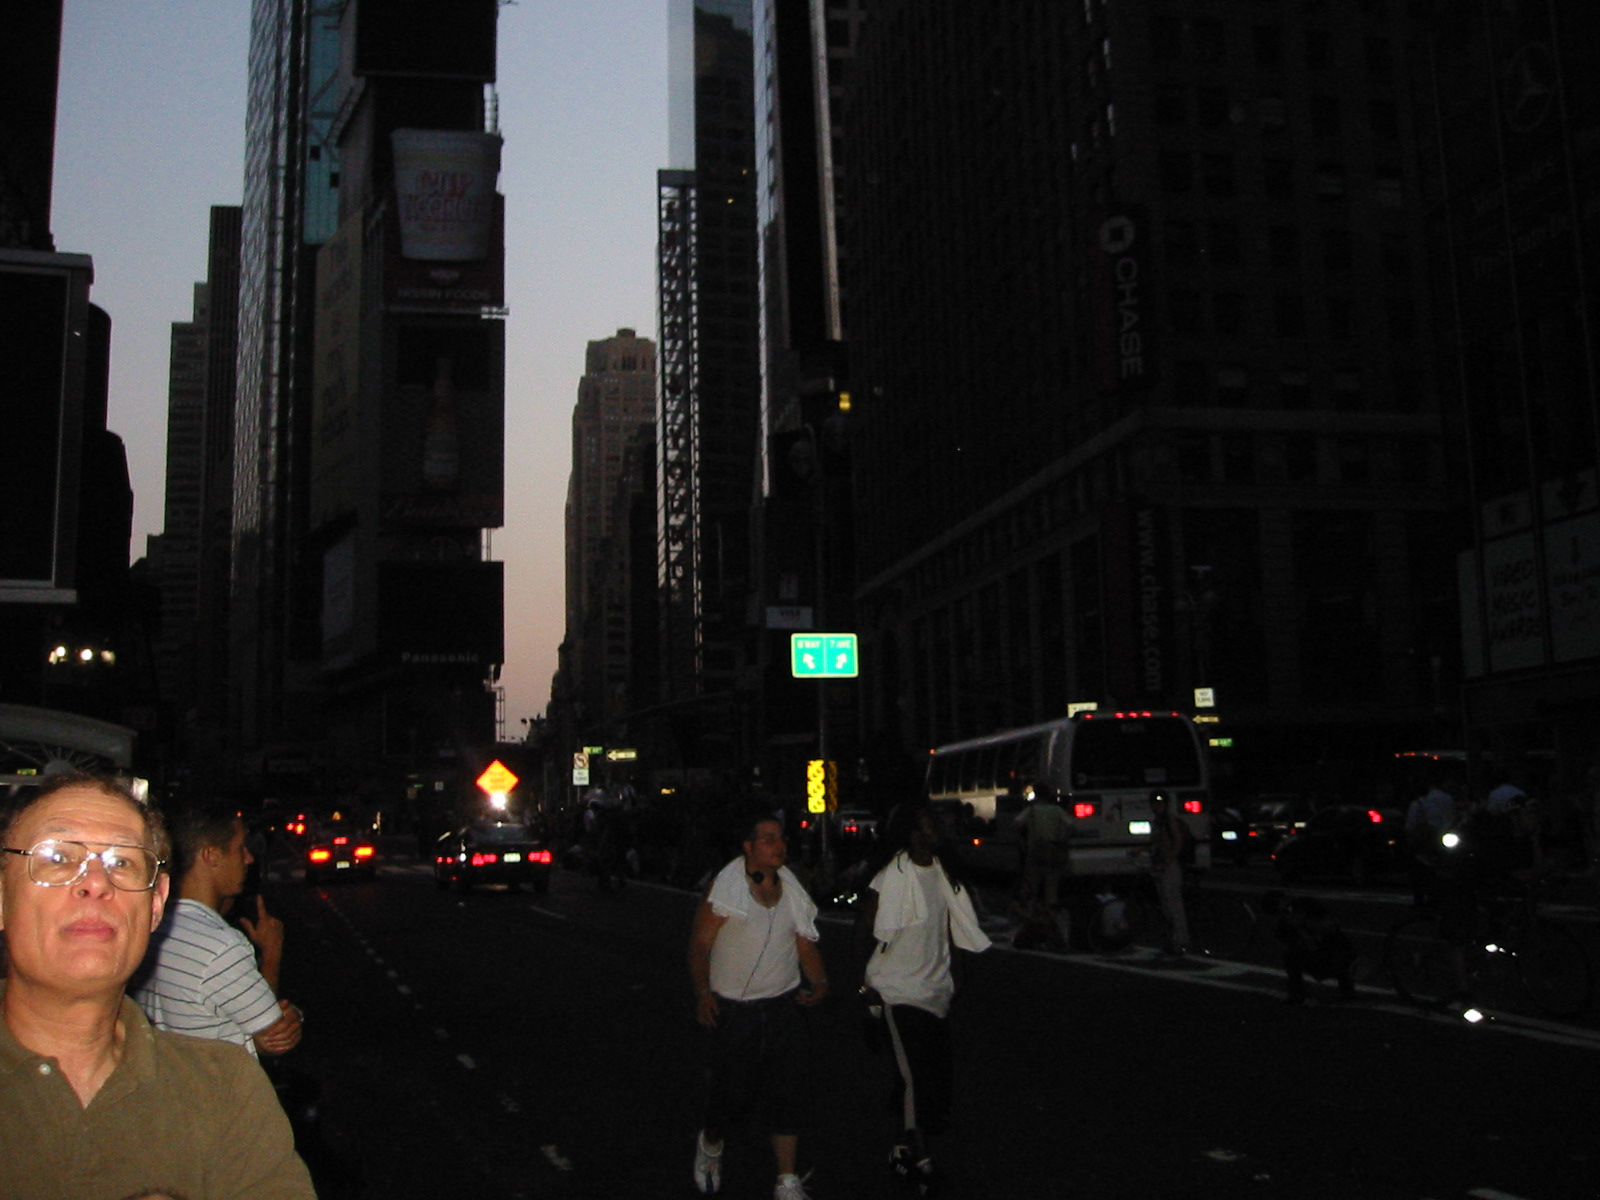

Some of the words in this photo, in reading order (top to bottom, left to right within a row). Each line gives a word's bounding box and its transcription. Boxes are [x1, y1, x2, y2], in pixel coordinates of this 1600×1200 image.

[1116, 256, 1144, 379] CHASE
[401, 651, 478, 663] Panasonic
[1137, 510, 1163, 691] www.chase.com
